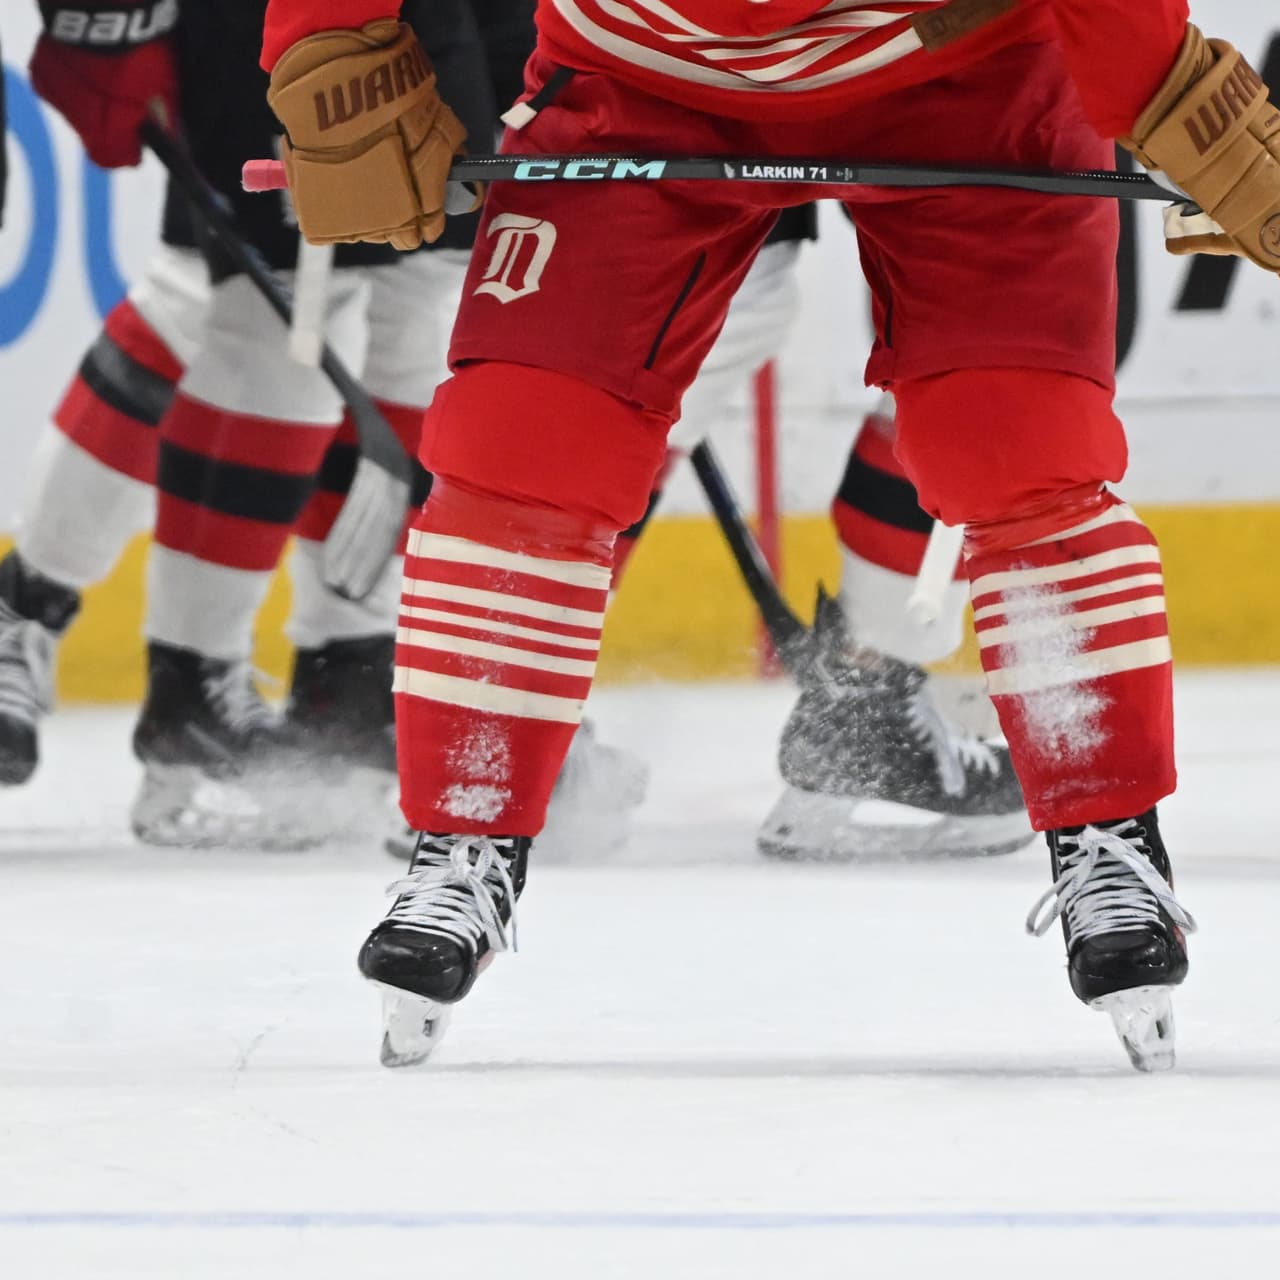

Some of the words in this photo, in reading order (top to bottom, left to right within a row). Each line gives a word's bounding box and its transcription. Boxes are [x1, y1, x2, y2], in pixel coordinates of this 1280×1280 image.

[513, 159, 667, 181] CCM
[741, 164, 804, 180] LARKIN
[809, 166, 827, 180] 71
[472, 212, 558, 305] D
